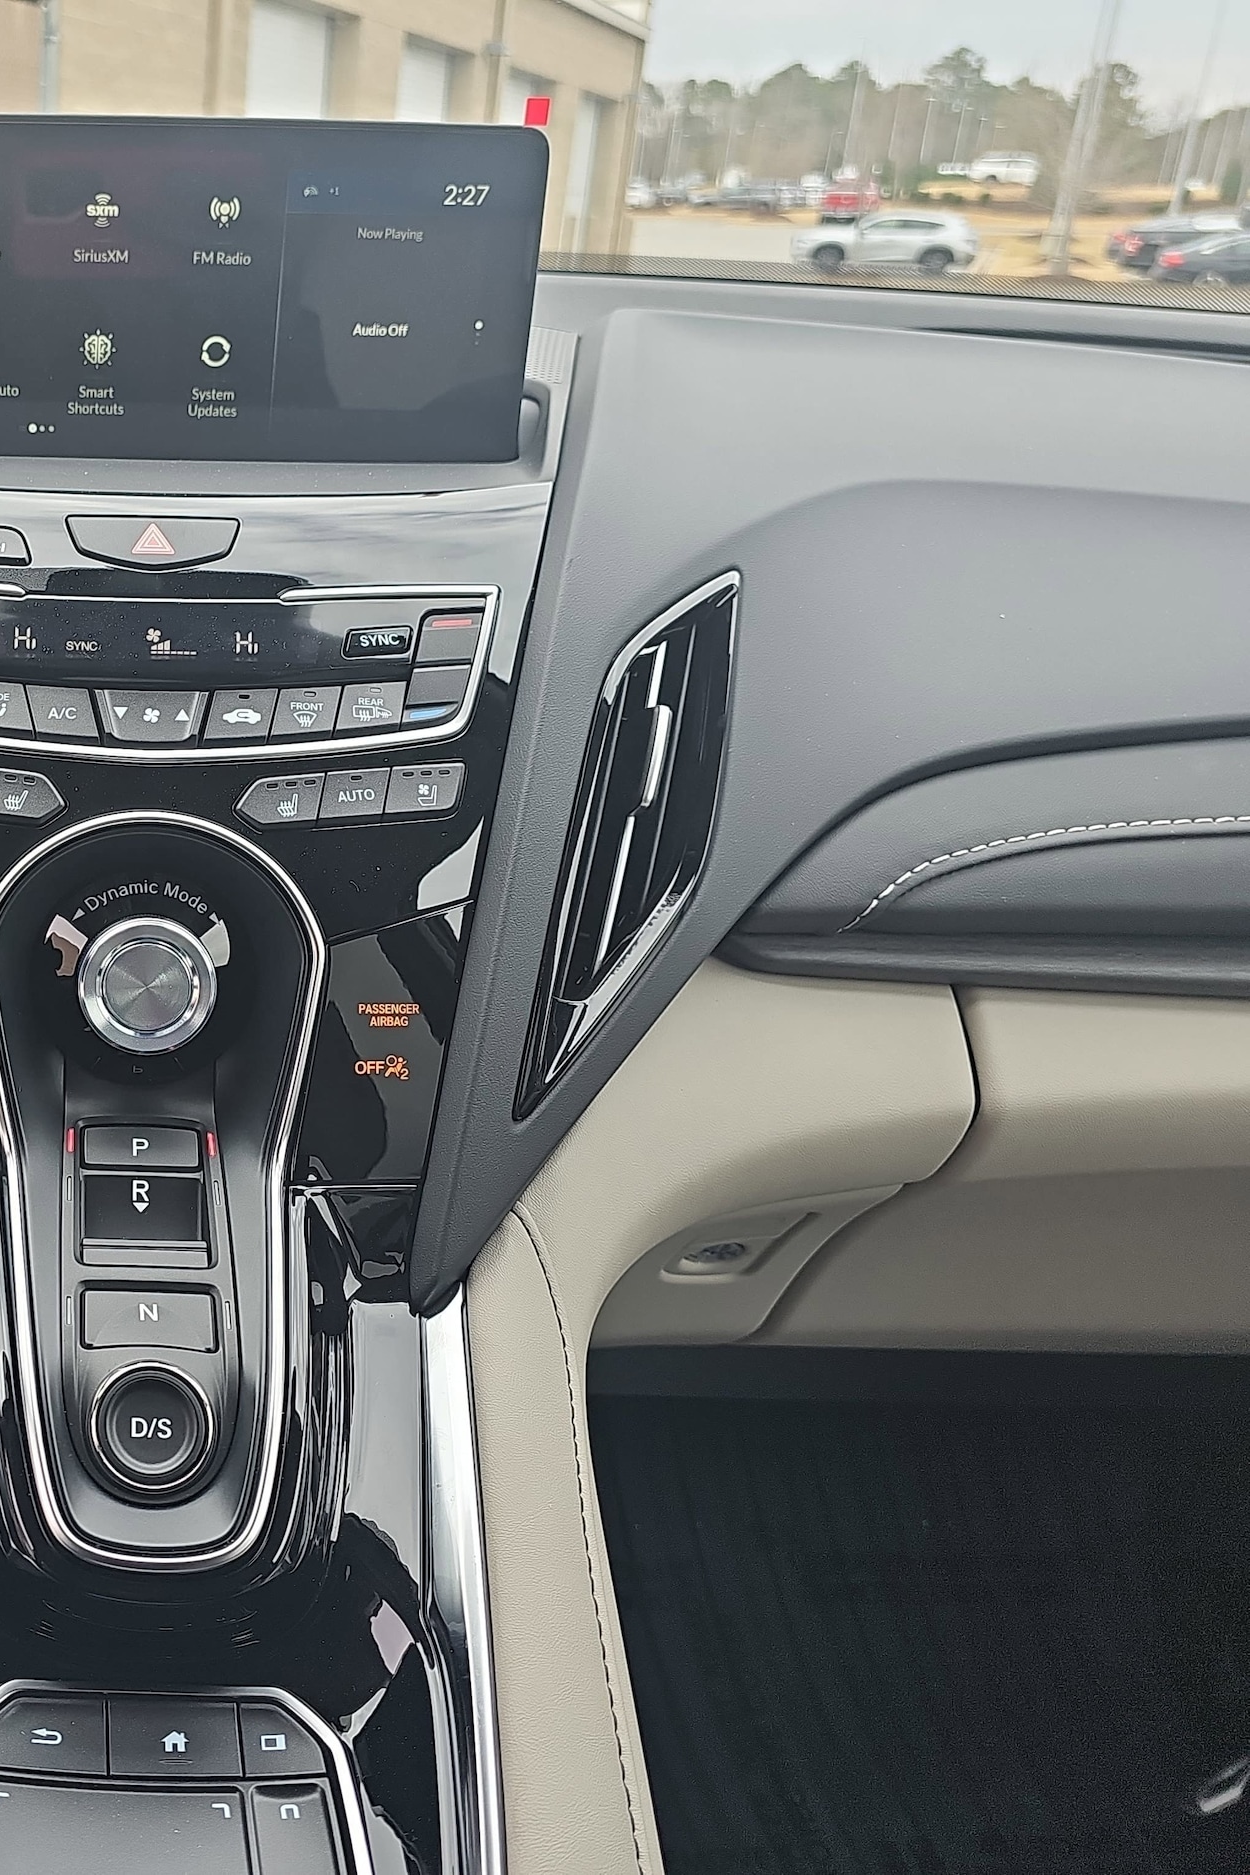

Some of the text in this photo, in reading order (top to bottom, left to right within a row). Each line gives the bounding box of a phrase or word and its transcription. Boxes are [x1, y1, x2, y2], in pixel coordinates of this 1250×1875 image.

[442, 184, 490, 206] 2:27
[357, 227, 424, 243] Now Playing
[73, 249, 129, 264] SiriusXM
[192, 251, 252, 267] FM Radio
[352, 322, 410, 338] Audio Off
[78, 385, 114, 399] Smart
[191, 387, 235, 403] System
[67, 402, 125, 416] Shortcuts
[187, 404, 238, 419] Updates
[65, 641, 99, 652] SYNC
[359, 632, 401, 648] SYNC
[290, 701, 324, 713] FRONT
[358, 696, 385, 708] REAR
[47, 706, 78, 721] A/C
[337, 788, 376, 804] AUTO
[84, 880, 208, 914] Dynamic Mode
[358, 1003, 420, 1015] PASSENGER
[369, 1015, 409, 1027] AIRBAG
[354, 1060, 385, 1075] OFF
[131, 1137, 150, 1157] P
[131, 1179, 150, 1203] R
[138, 1302, 160, 1322] N
[130, 1416, 172, 1440] D/S
